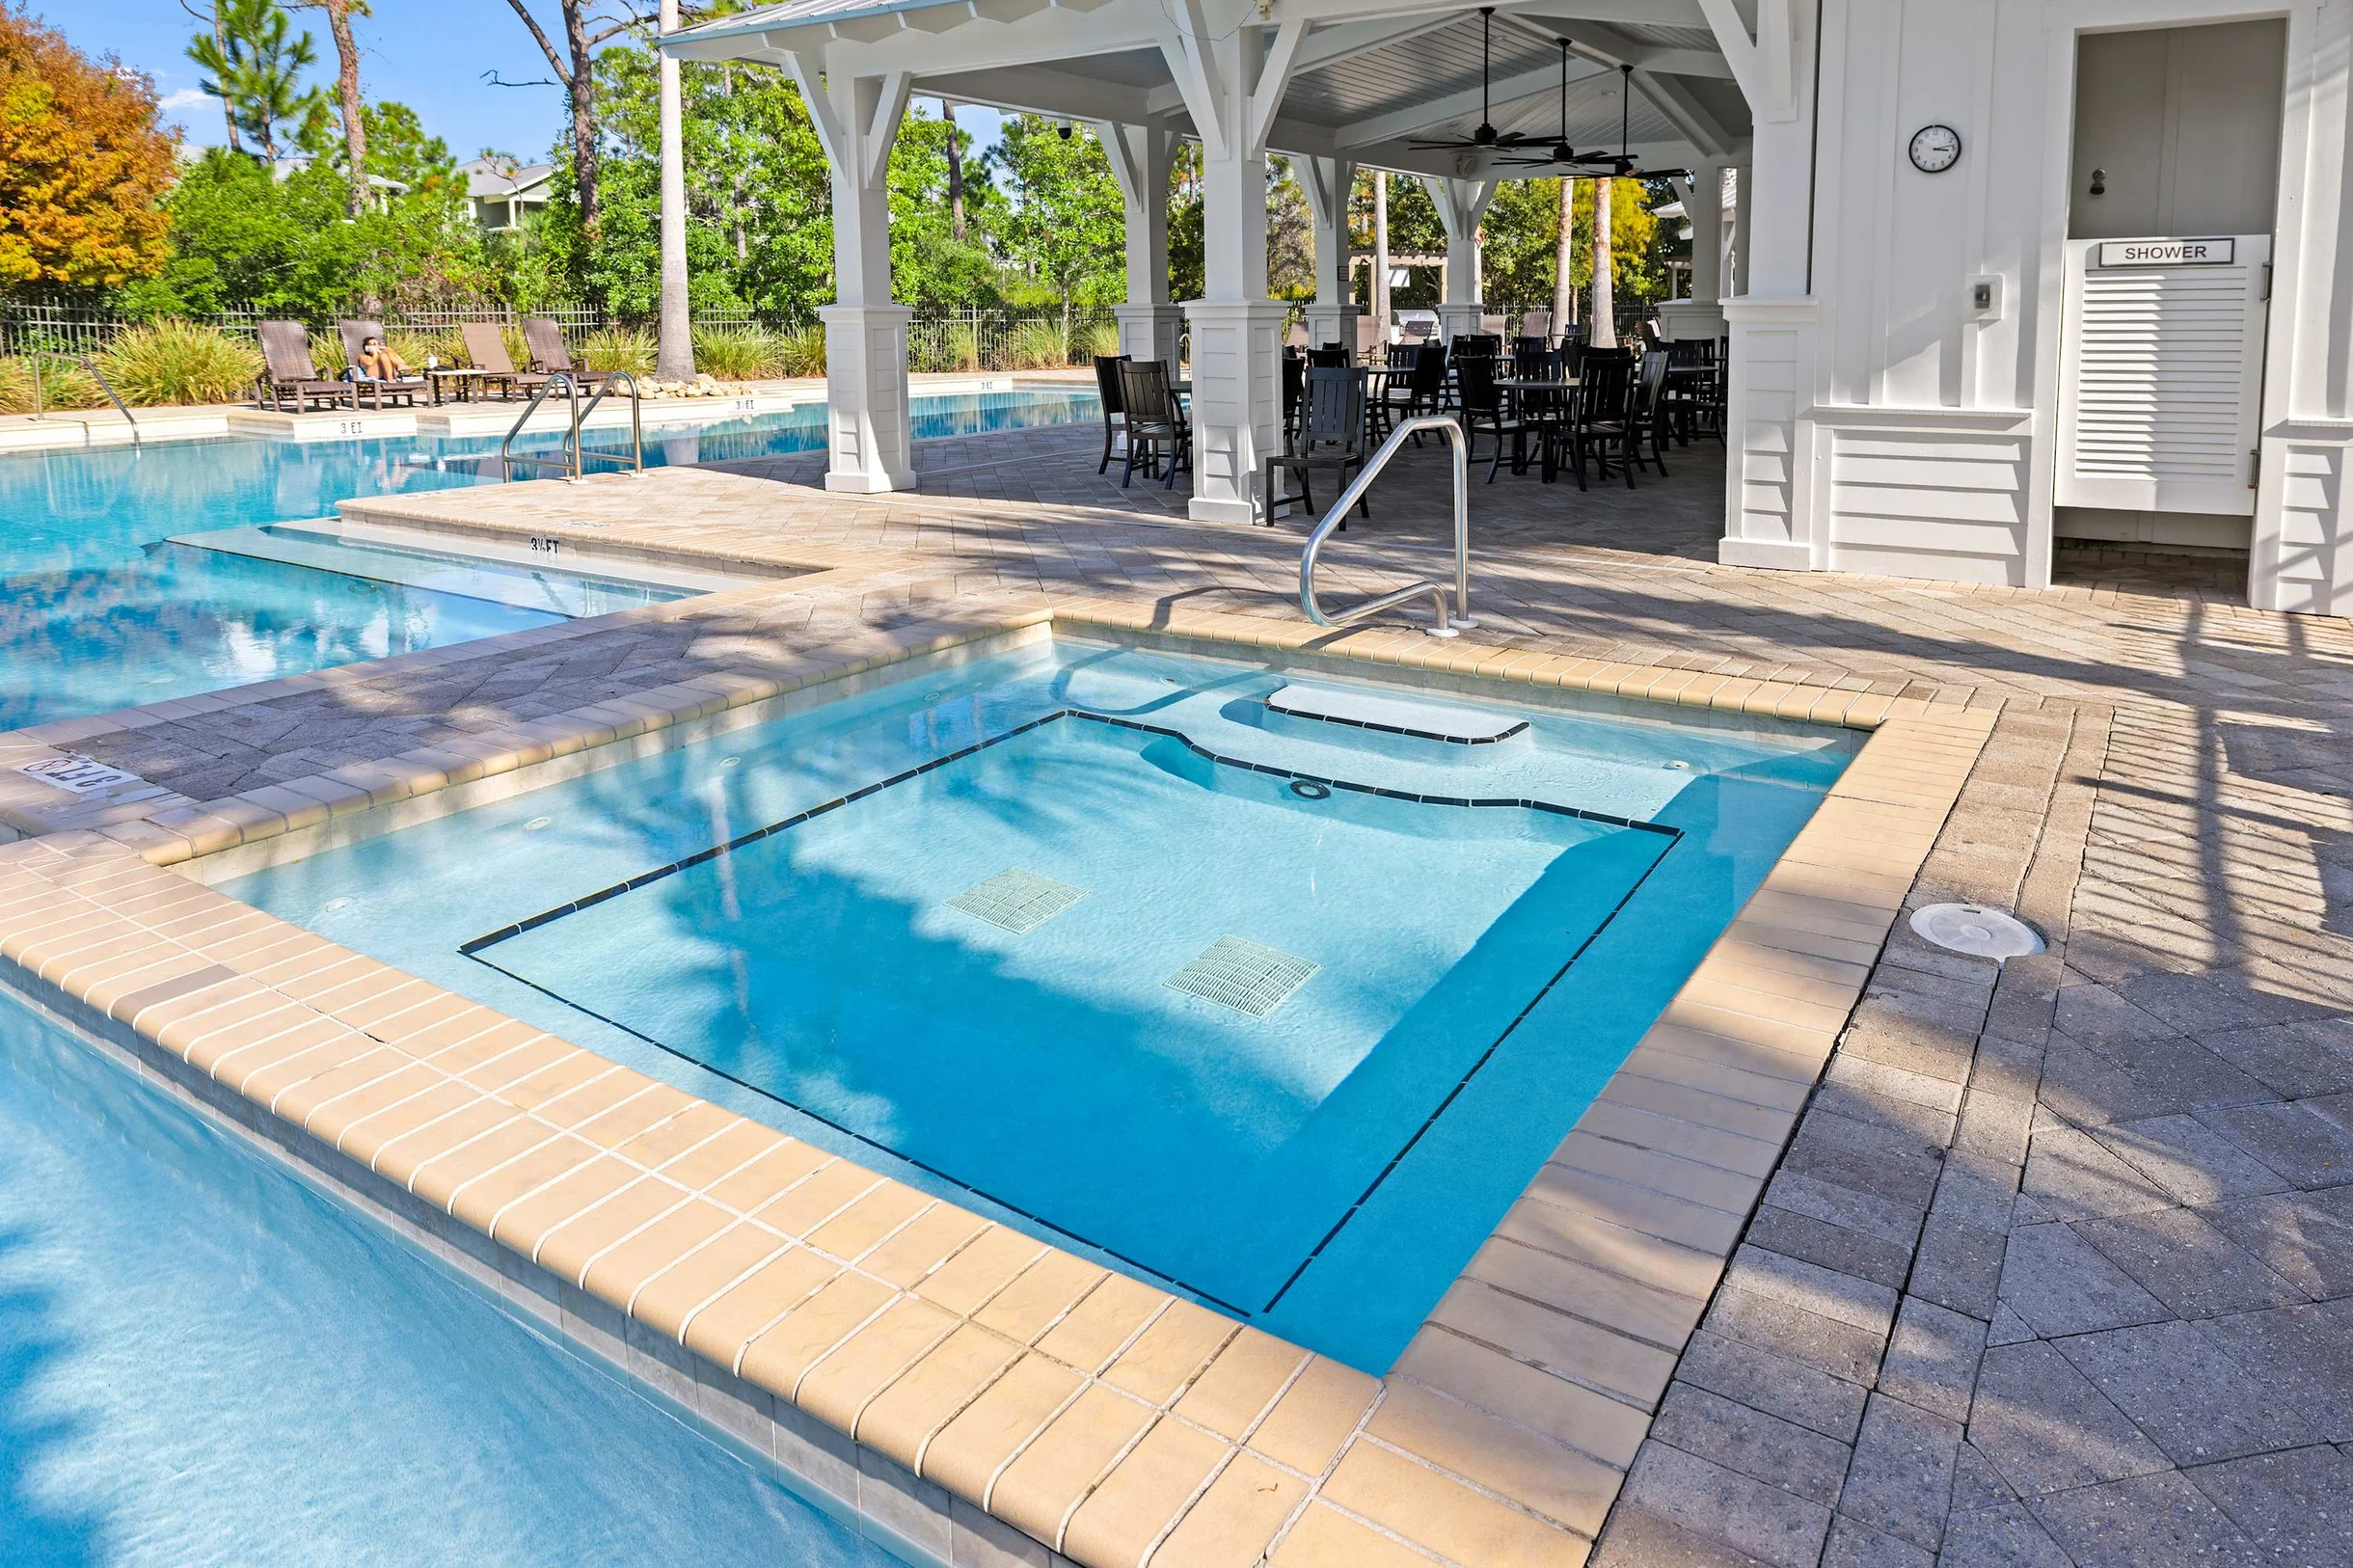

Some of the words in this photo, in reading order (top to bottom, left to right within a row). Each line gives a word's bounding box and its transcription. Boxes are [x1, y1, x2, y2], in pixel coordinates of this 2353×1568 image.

[2125, 246, 2206, 259] SHOWER
[340, 422, 347, 434] 3
[546, 539, 559, 554] FT
[75, 775, 122, 787] 3
